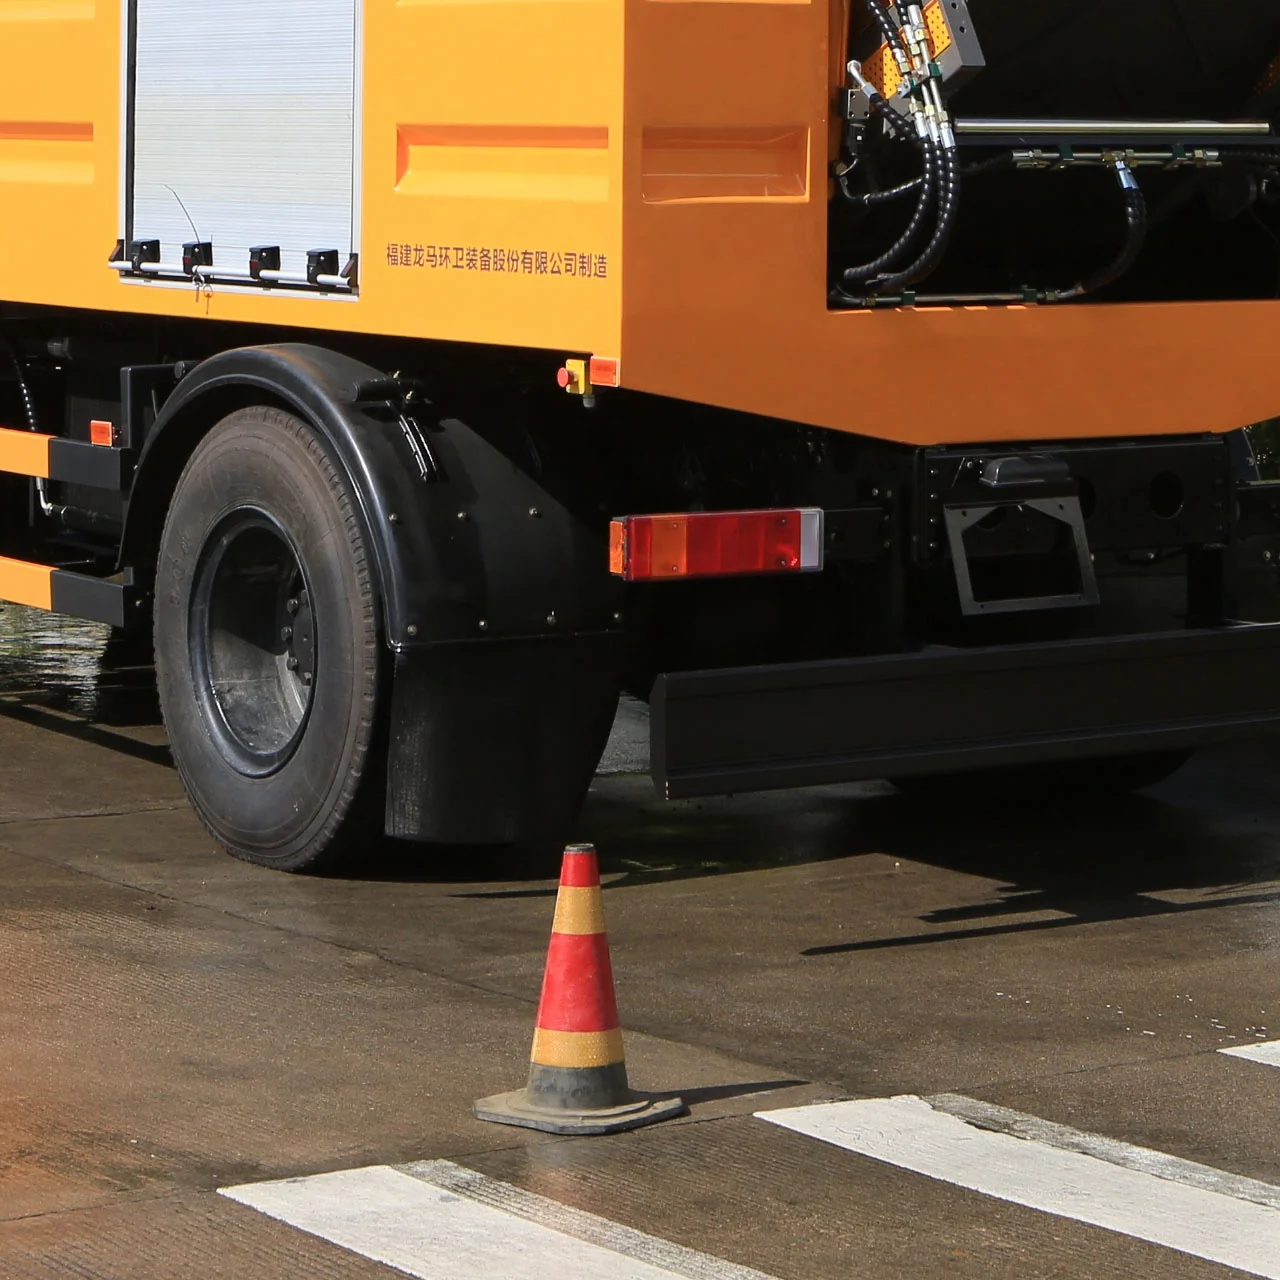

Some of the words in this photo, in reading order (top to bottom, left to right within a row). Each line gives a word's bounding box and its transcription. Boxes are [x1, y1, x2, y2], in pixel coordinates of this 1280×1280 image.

[386, 243, 608, 279] 福建龙马环卫装备股份有限公司制造
